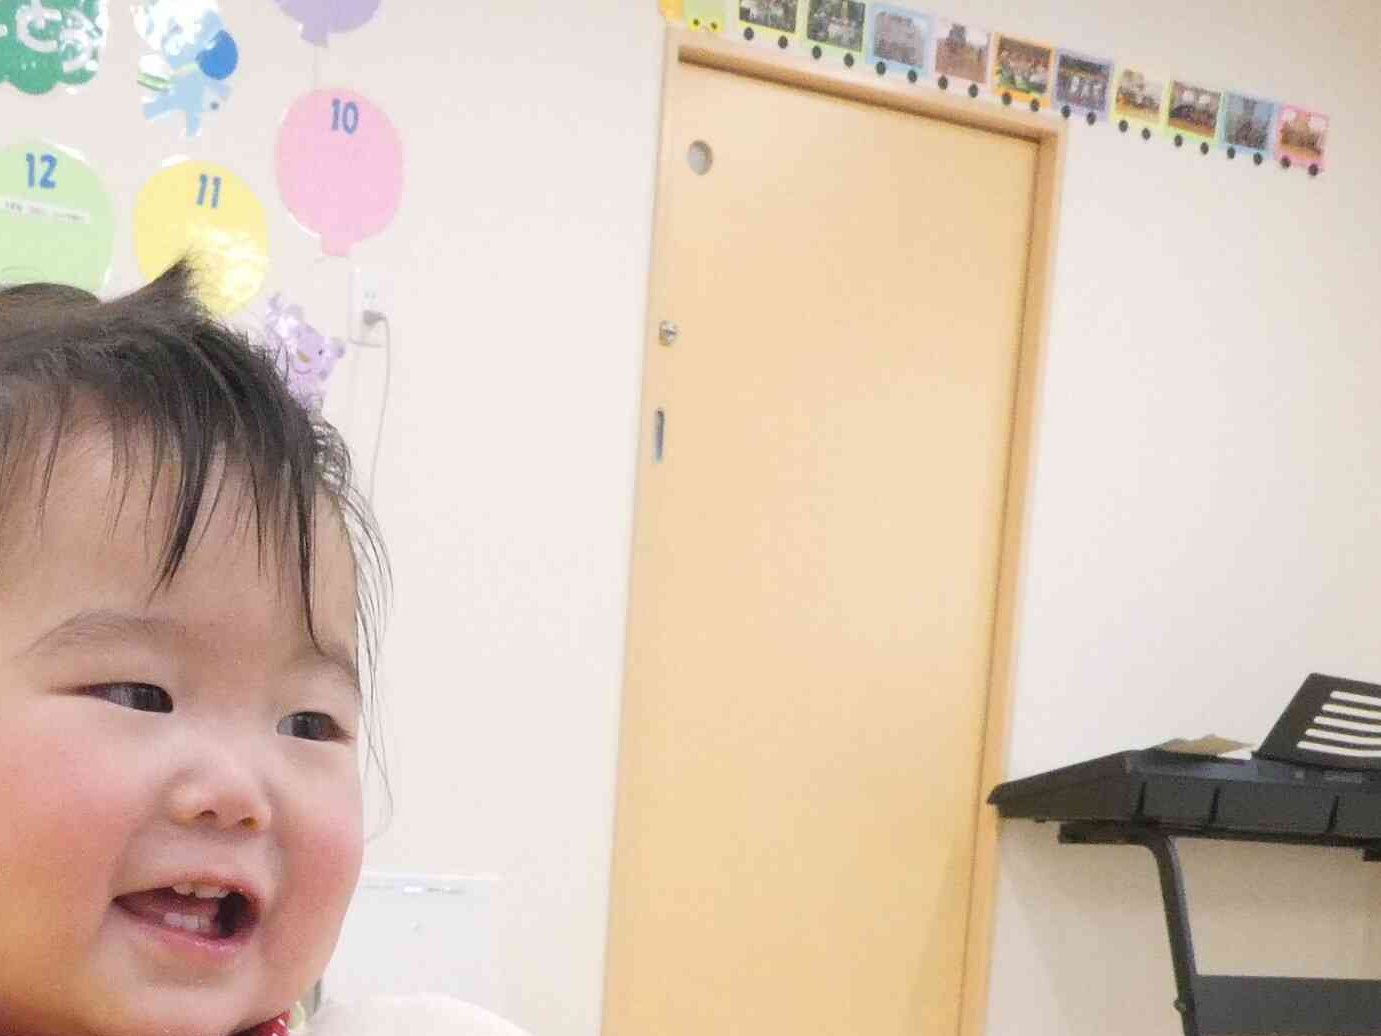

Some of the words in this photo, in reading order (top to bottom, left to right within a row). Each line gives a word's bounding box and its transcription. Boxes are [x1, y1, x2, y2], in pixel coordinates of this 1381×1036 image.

[331, 97, 359, 134] 10
[25, 152, 58, 189] 12
[196, 173, 221, 208] 11
